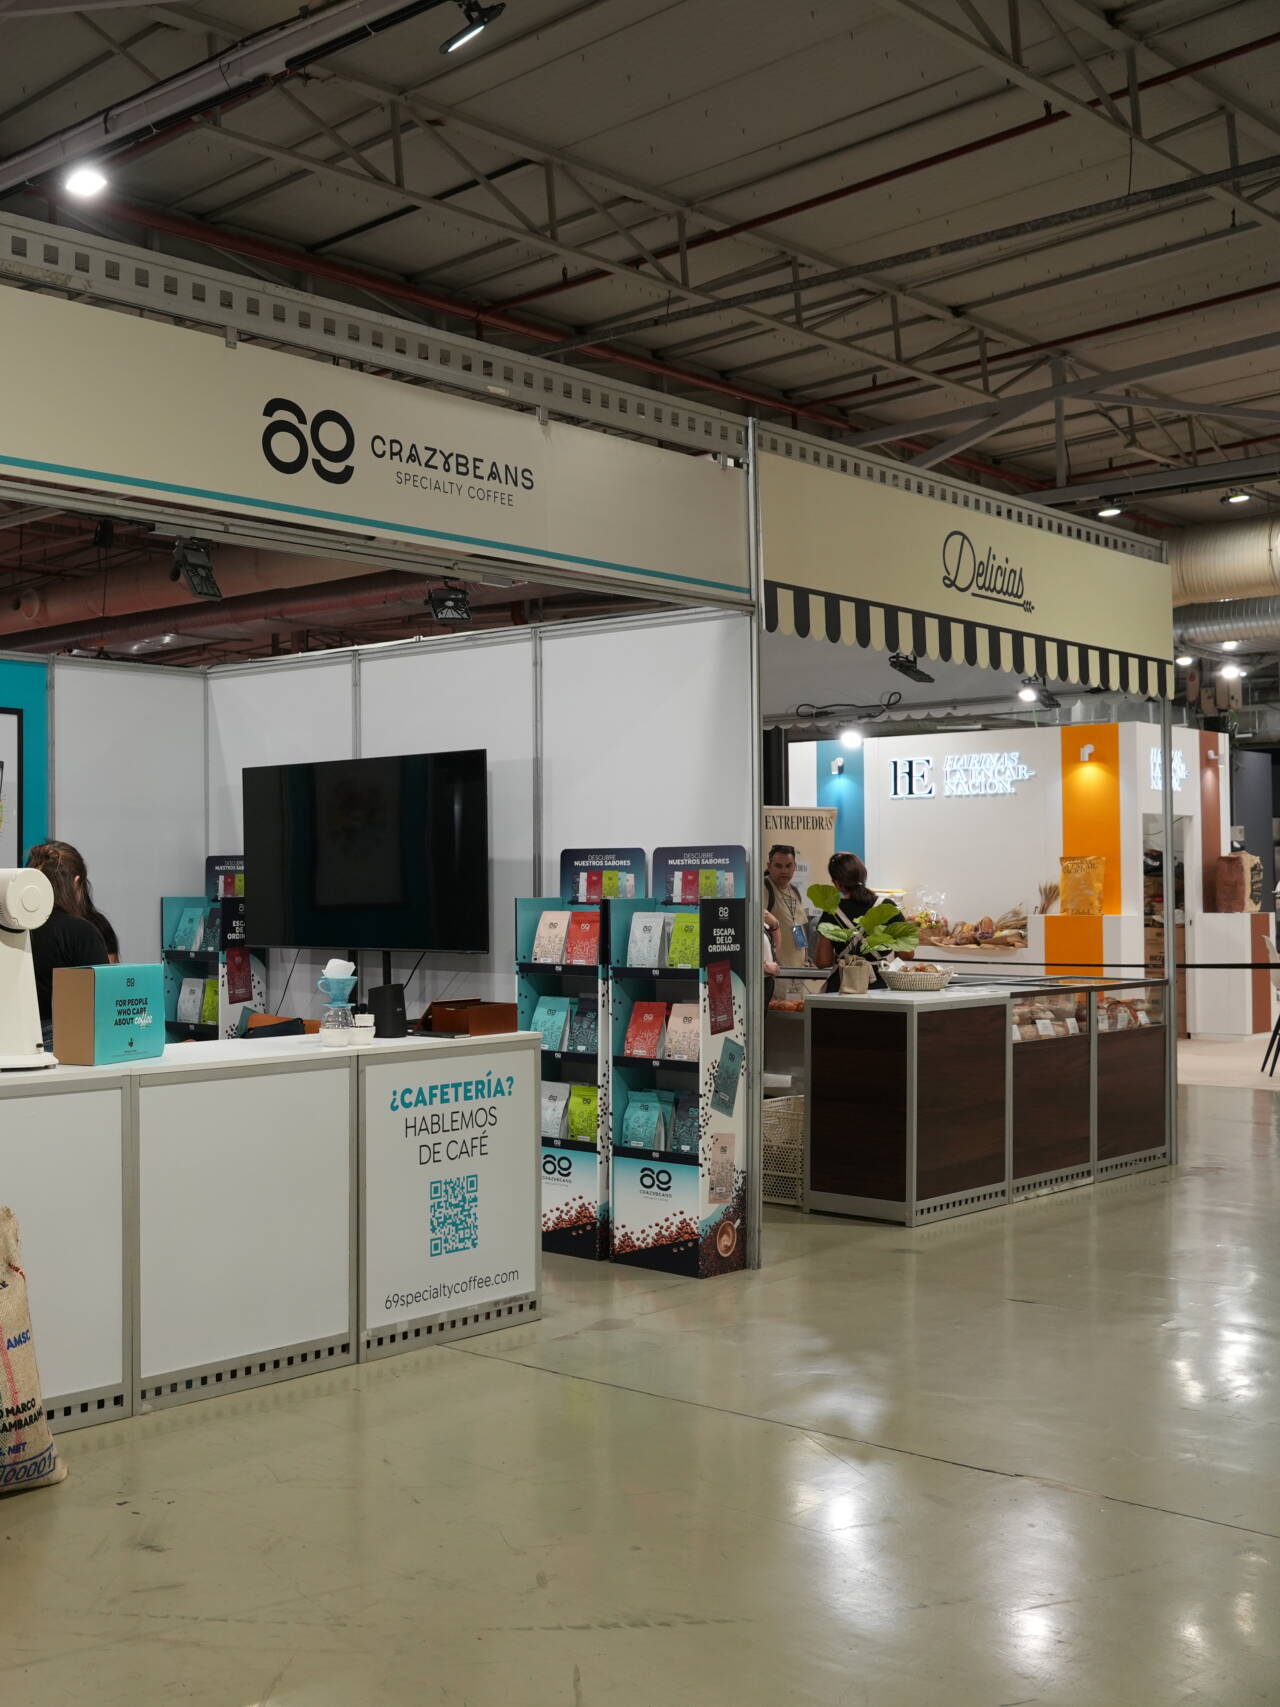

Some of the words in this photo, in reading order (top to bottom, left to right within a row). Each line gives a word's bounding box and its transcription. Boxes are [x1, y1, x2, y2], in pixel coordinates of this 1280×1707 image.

[371, 435, 534, 490] CRAZYBEANS
[395, 471, 463, 497] SPECIALTY
[468, 486, 514, 507] COFFEE
[942, 530, 1024, 599] Delicias
[764, 815, 833, 830] ENTREPIEDRAS
[713, 928, 735, 936] ESCAPA
[716, 936, 724, 944] DE
[724, 936, 732, 944] LO
[708, 944, 740, 953] ORDINARIO
[127, 998, 148, 1006] PEOPLE
[114, 1018, 134, 1026] ABOUT
[134, 1011, 153, 1027] coffee
[390, 1070, 514, 1111] ¿CAFETERÍA?
[405, 1106, 498, 1138] HABLEMOS
[419, 1142, 442, 1165] DE
[446, 1131, 489, 1161] CAFÉ
[384, 1269, 519, 1310] 69specialtycoffee.com
[6, 1329, 31, 1350] AMSC
[5, 1398, 36, 1417] MARCO
[8, 1442, 27, 1456] NET
